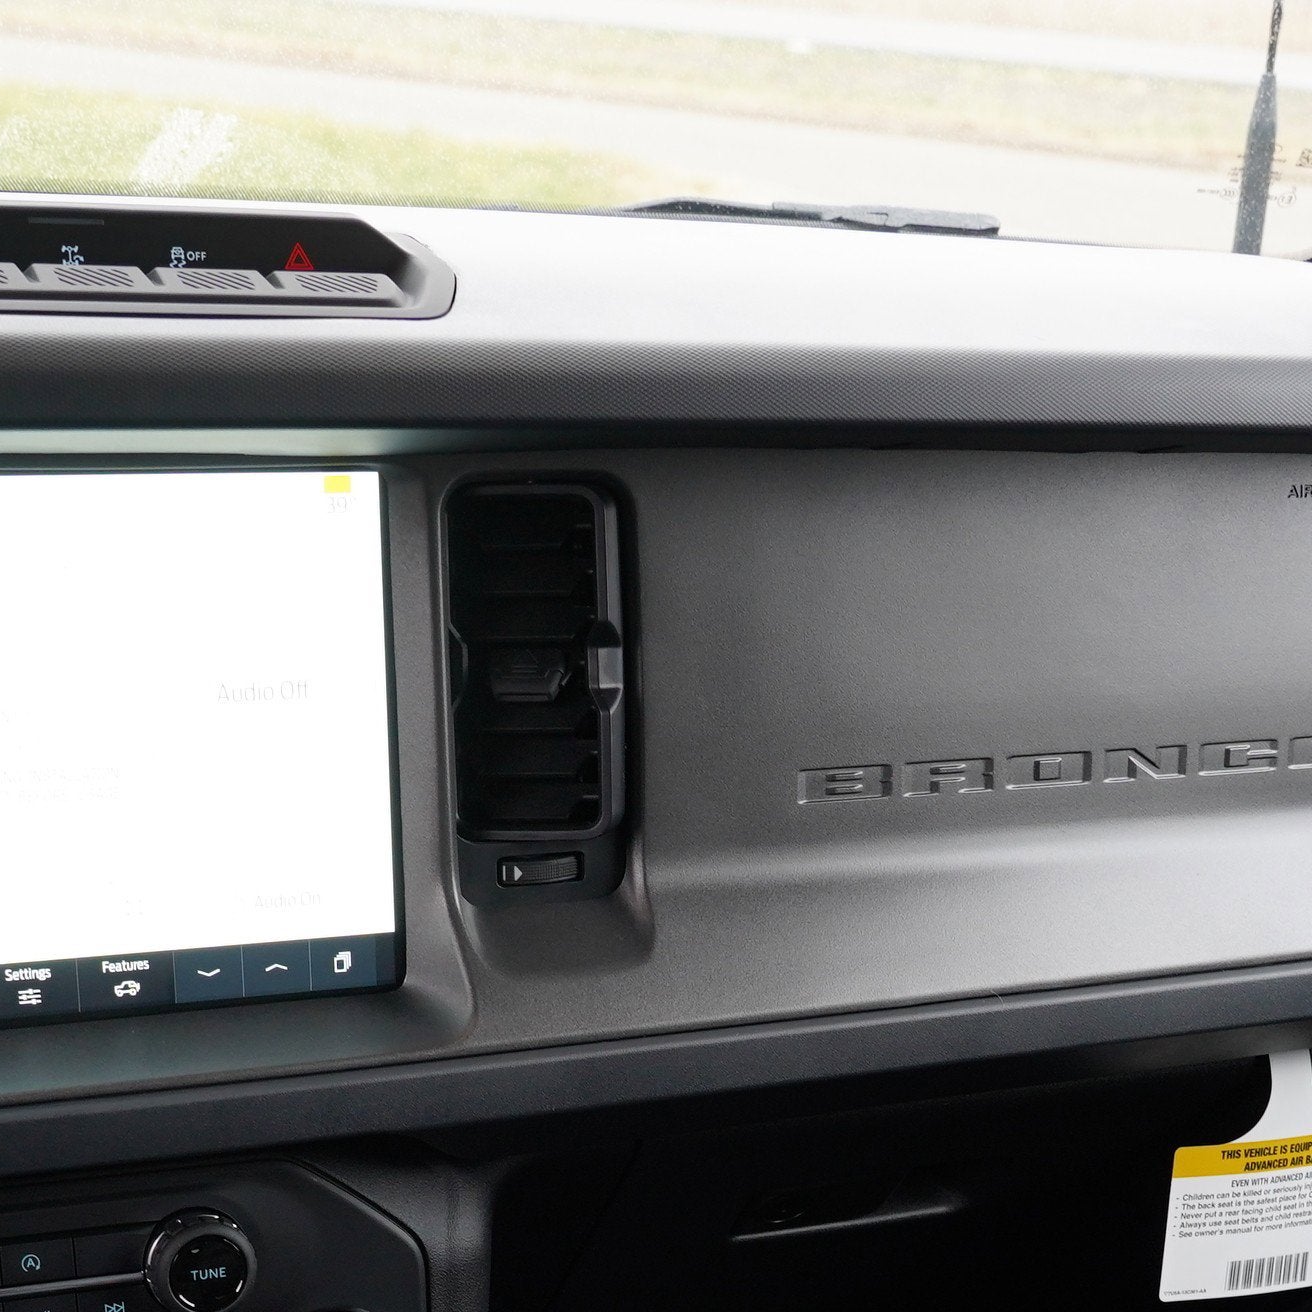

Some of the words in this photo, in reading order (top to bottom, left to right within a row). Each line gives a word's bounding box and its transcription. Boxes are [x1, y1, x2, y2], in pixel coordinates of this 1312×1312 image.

[186, 250, 207, 261] OFF
[218, 680, 275, 702] Audio
[101, 959, 150, 973] Features
[4, 967, 52, 982] Settings
[1221, 1150, 1242, 1160] THIS
[1243, 1146, 1278, 1158] VEHICLE
[1280, 1144, 1288, 1155] IS
[1244, 1158, 1288, 1172] ADVANCED
[1290, 1156, 1304, 1167] AIR
[1231, 1179, 1249, 1188] EVEN
[1251, 1177, 1269, 1186] WITH
[1270, 1173, 1304, 1184] ADVANCED
[1182, 1193, 1215, 1202] Children
[1232, 1191, 1241, 1199] be
[1243, 1189, 1262, 1197] killed
[1272, 1184, 1302, 1194] seriously
[1181, 1203, 1196, 1211] The
[1197, 1202, 1215, 1210] back
[1256, 1196, 1277, 1205] safest
[1278, 1194, 1296, 1203] place
[1298, 1192, 1307, 1200] for
[1180, 1212, 1202, 1220] Never
[1204, 1211, 1217, 1220] put
[1241, 1208, 1263, 1217] facing
[1265, 1205, 1282, 1213] child
[1283, 1203, 1297, 1211] seat
[1179, 1221, 1206, 1230] Always
[1224, 1218, 1240, 1226] seat
[1241, 1216, 1259, 1224] belts
[1260, 1214, 1273, 1222] and
[1274, 1212, 1291, 1221] child
[1178, 1230, 1193, 1238] See
[1194, 1229, 1224, 1237] owner's
[1225, 1226, 1252, 1235] manual
[1253, 1223, 1264, 1232] for
[1265, 1223, 1282, 1231] more
[190, 1266, 227, 1281] TUNE
